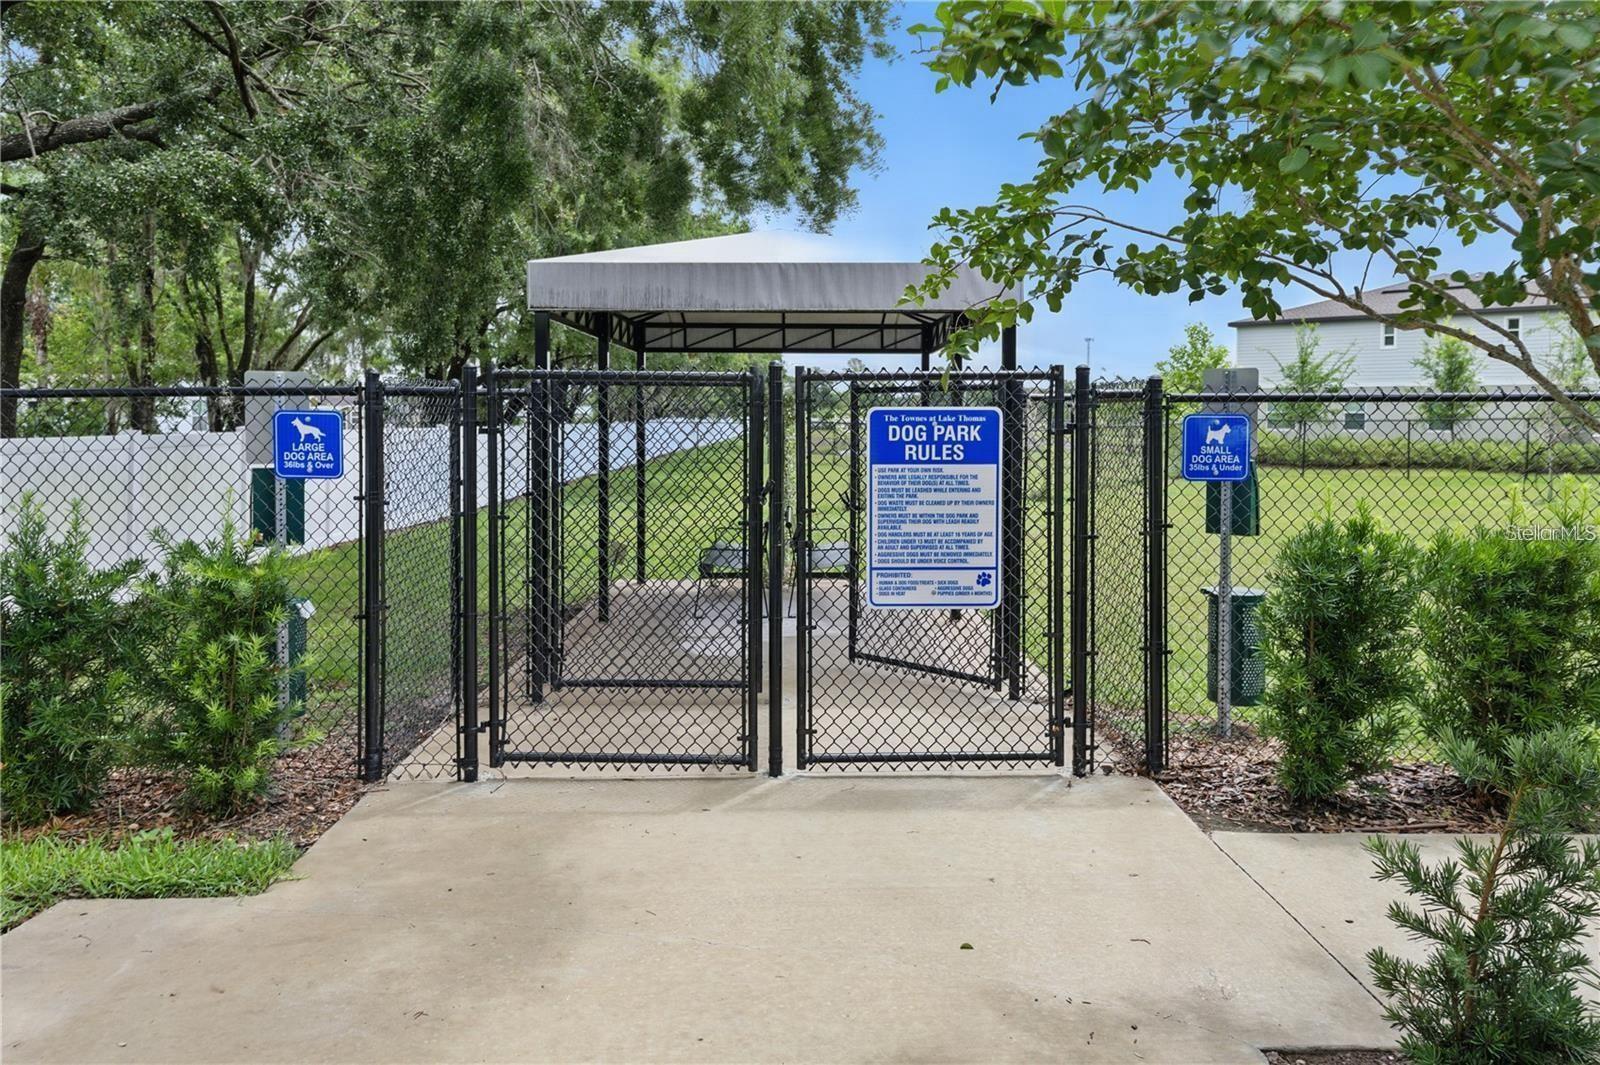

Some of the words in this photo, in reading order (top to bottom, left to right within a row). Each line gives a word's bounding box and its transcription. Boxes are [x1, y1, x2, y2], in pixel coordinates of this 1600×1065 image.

[888, 424, 926, 442] DOG
[934, 424, 982, 442] PARK
[292, 442, 325, 452] LARGE
[904, 444, 964, 460] RULES
[1200, 446, 1232, 454] SMALL
[284, 452, 305, 460] DOG
[307, 452, 334, 461] AREA
[1192, 454, 1212, 464] DOG
[1214, 455, 1240, 464] AREA
